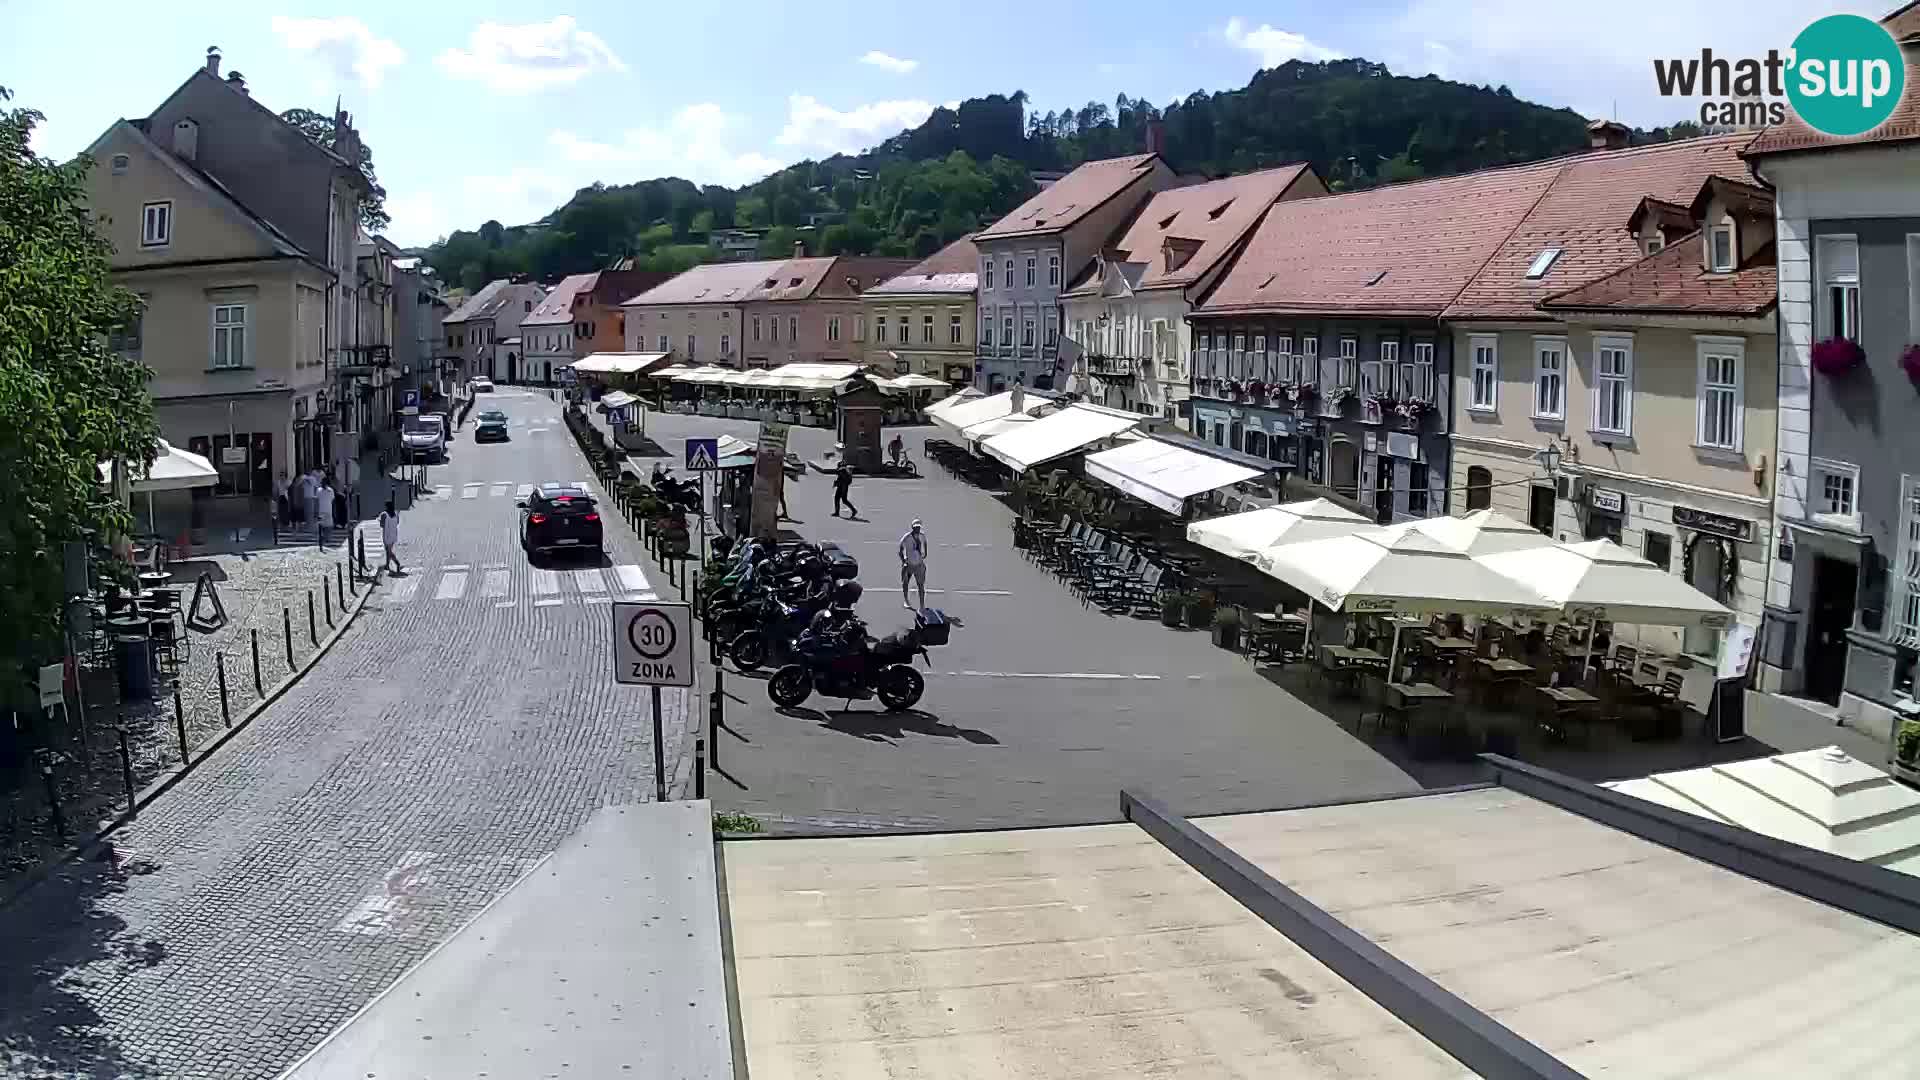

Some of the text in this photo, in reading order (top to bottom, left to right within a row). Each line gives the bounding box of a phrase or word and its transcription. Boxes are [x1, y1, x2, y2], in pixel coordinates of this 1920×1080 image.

[407, 393, 415, 405] P
[641, 625, 665, 646] 30
[631, 662, 676, 679] ZONA
